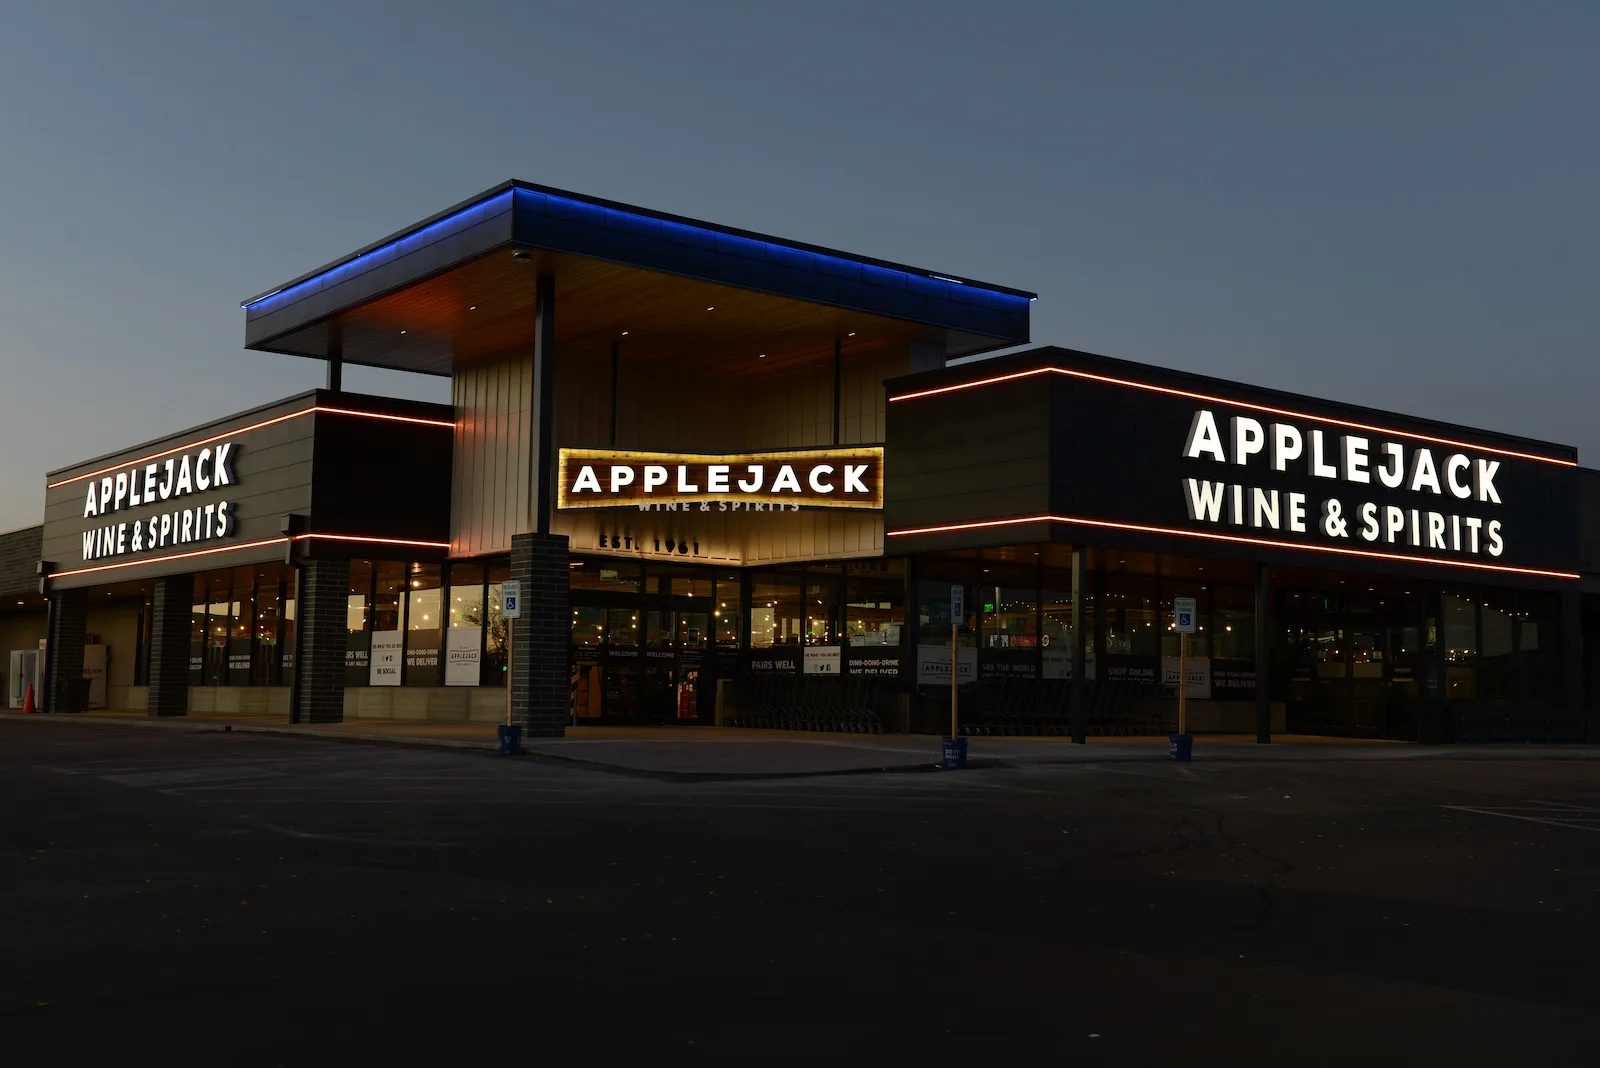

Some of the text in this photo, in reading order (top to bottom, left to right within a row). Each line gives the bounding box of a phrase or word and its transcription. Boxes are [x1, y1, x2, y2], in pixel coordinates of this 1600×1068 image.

[1182, 410, 1502, 504] APPLEJACK
[83, 442, 233, 518] APPLEJACK
[571, 465, 870, 493] APPLEJACK
[638, 501, 800, 512] WINE & SPIRITS
[1182, 478, 1504, 557] WINE & SPIRITS
[82, 501, 229, 560] WINE & SPIRITS
[599, 535, 699, 555] EST. 1961
[355, 650, 369, 659] WELL
[407, 657, 438, 666] WE DELIVER
[752, 660, 795, 669] PAIRS WELL
[981, 663, 995, 671] SEE
[1012, 664, 1036, 672] WORLD
[1108, 667, 1154, 677] SHOP ONLINE
[1215, 679, 1256, 689] WE DELIVER
